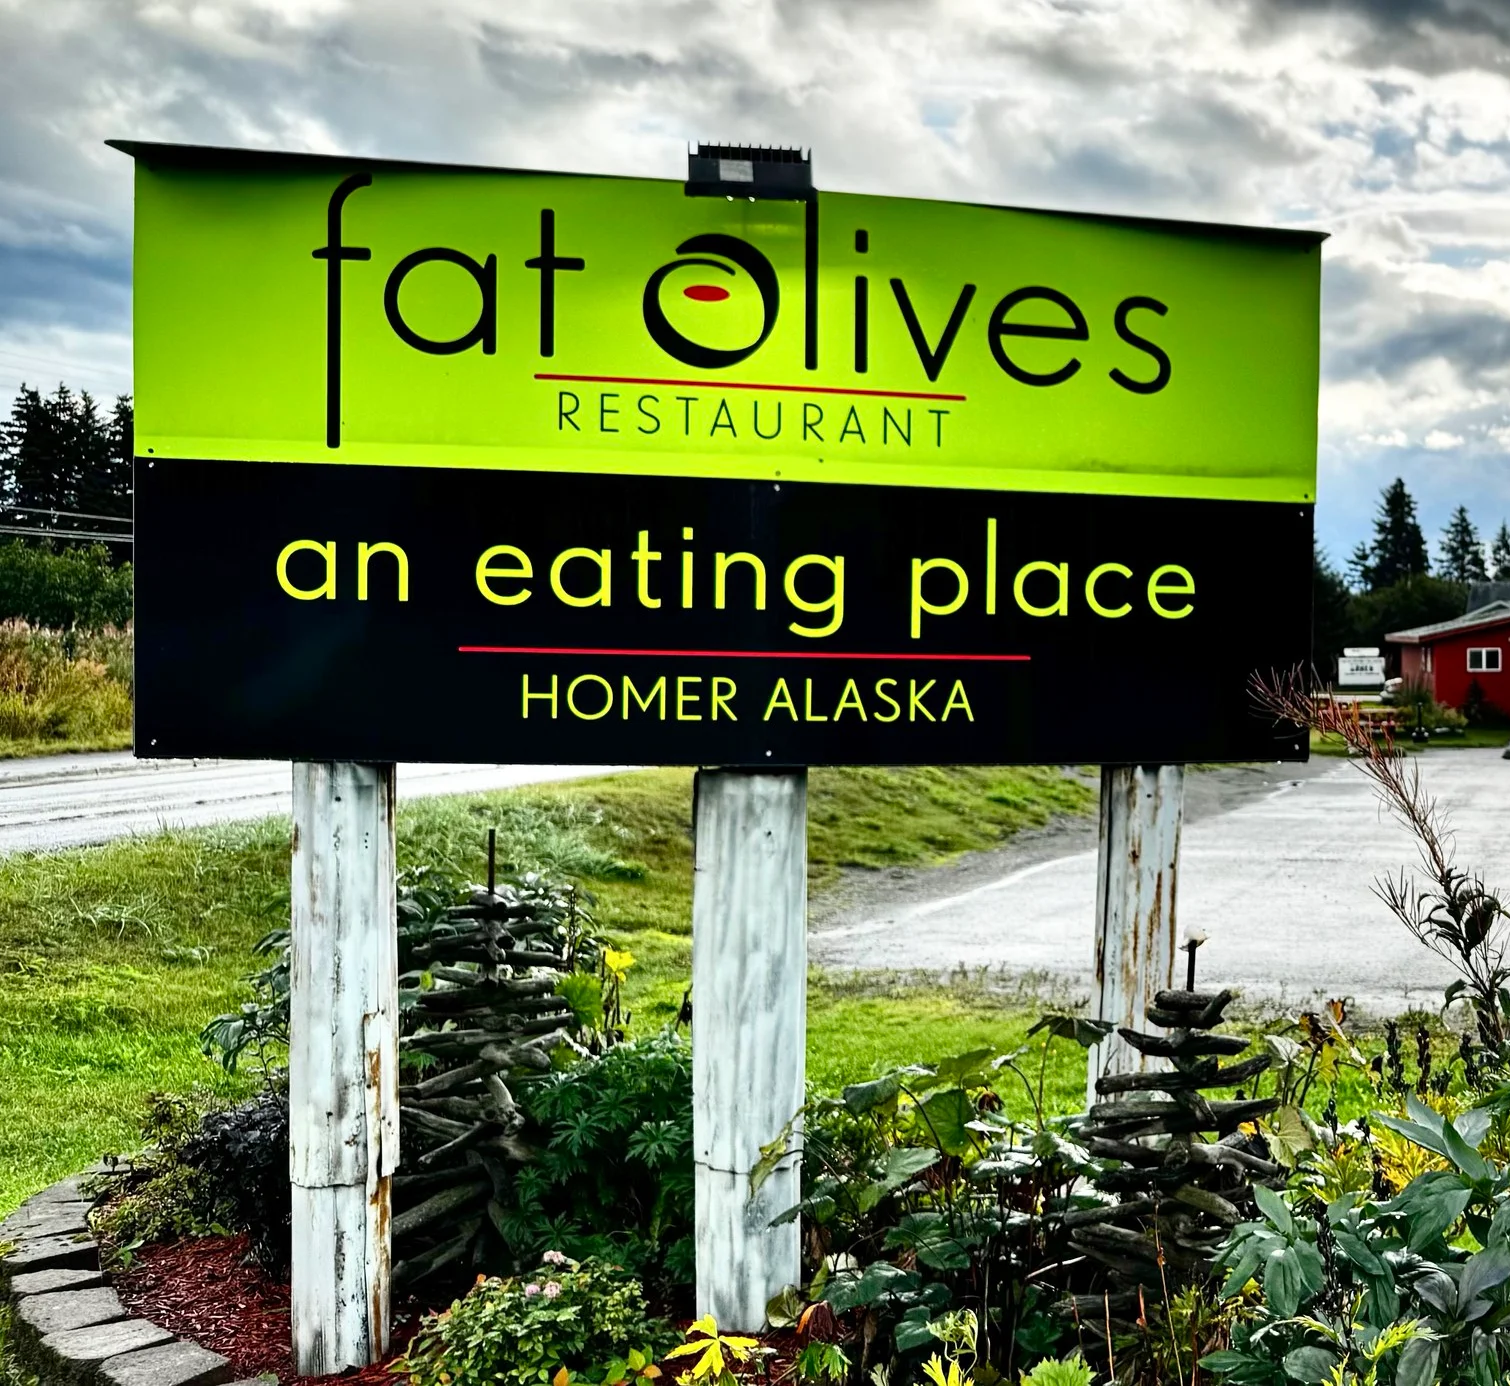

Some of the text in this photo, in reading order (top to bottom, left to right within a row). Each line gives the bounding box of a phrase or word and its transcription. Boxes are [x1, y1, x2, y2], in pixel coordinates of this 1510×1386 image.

[312, 173, 1172, 449] fat olives
[557, 391, 951, 448] RESTAURANT
[276, 517, 1196, 639] an eating place
[522, 673, 975, 723] HOMER ALASKA
